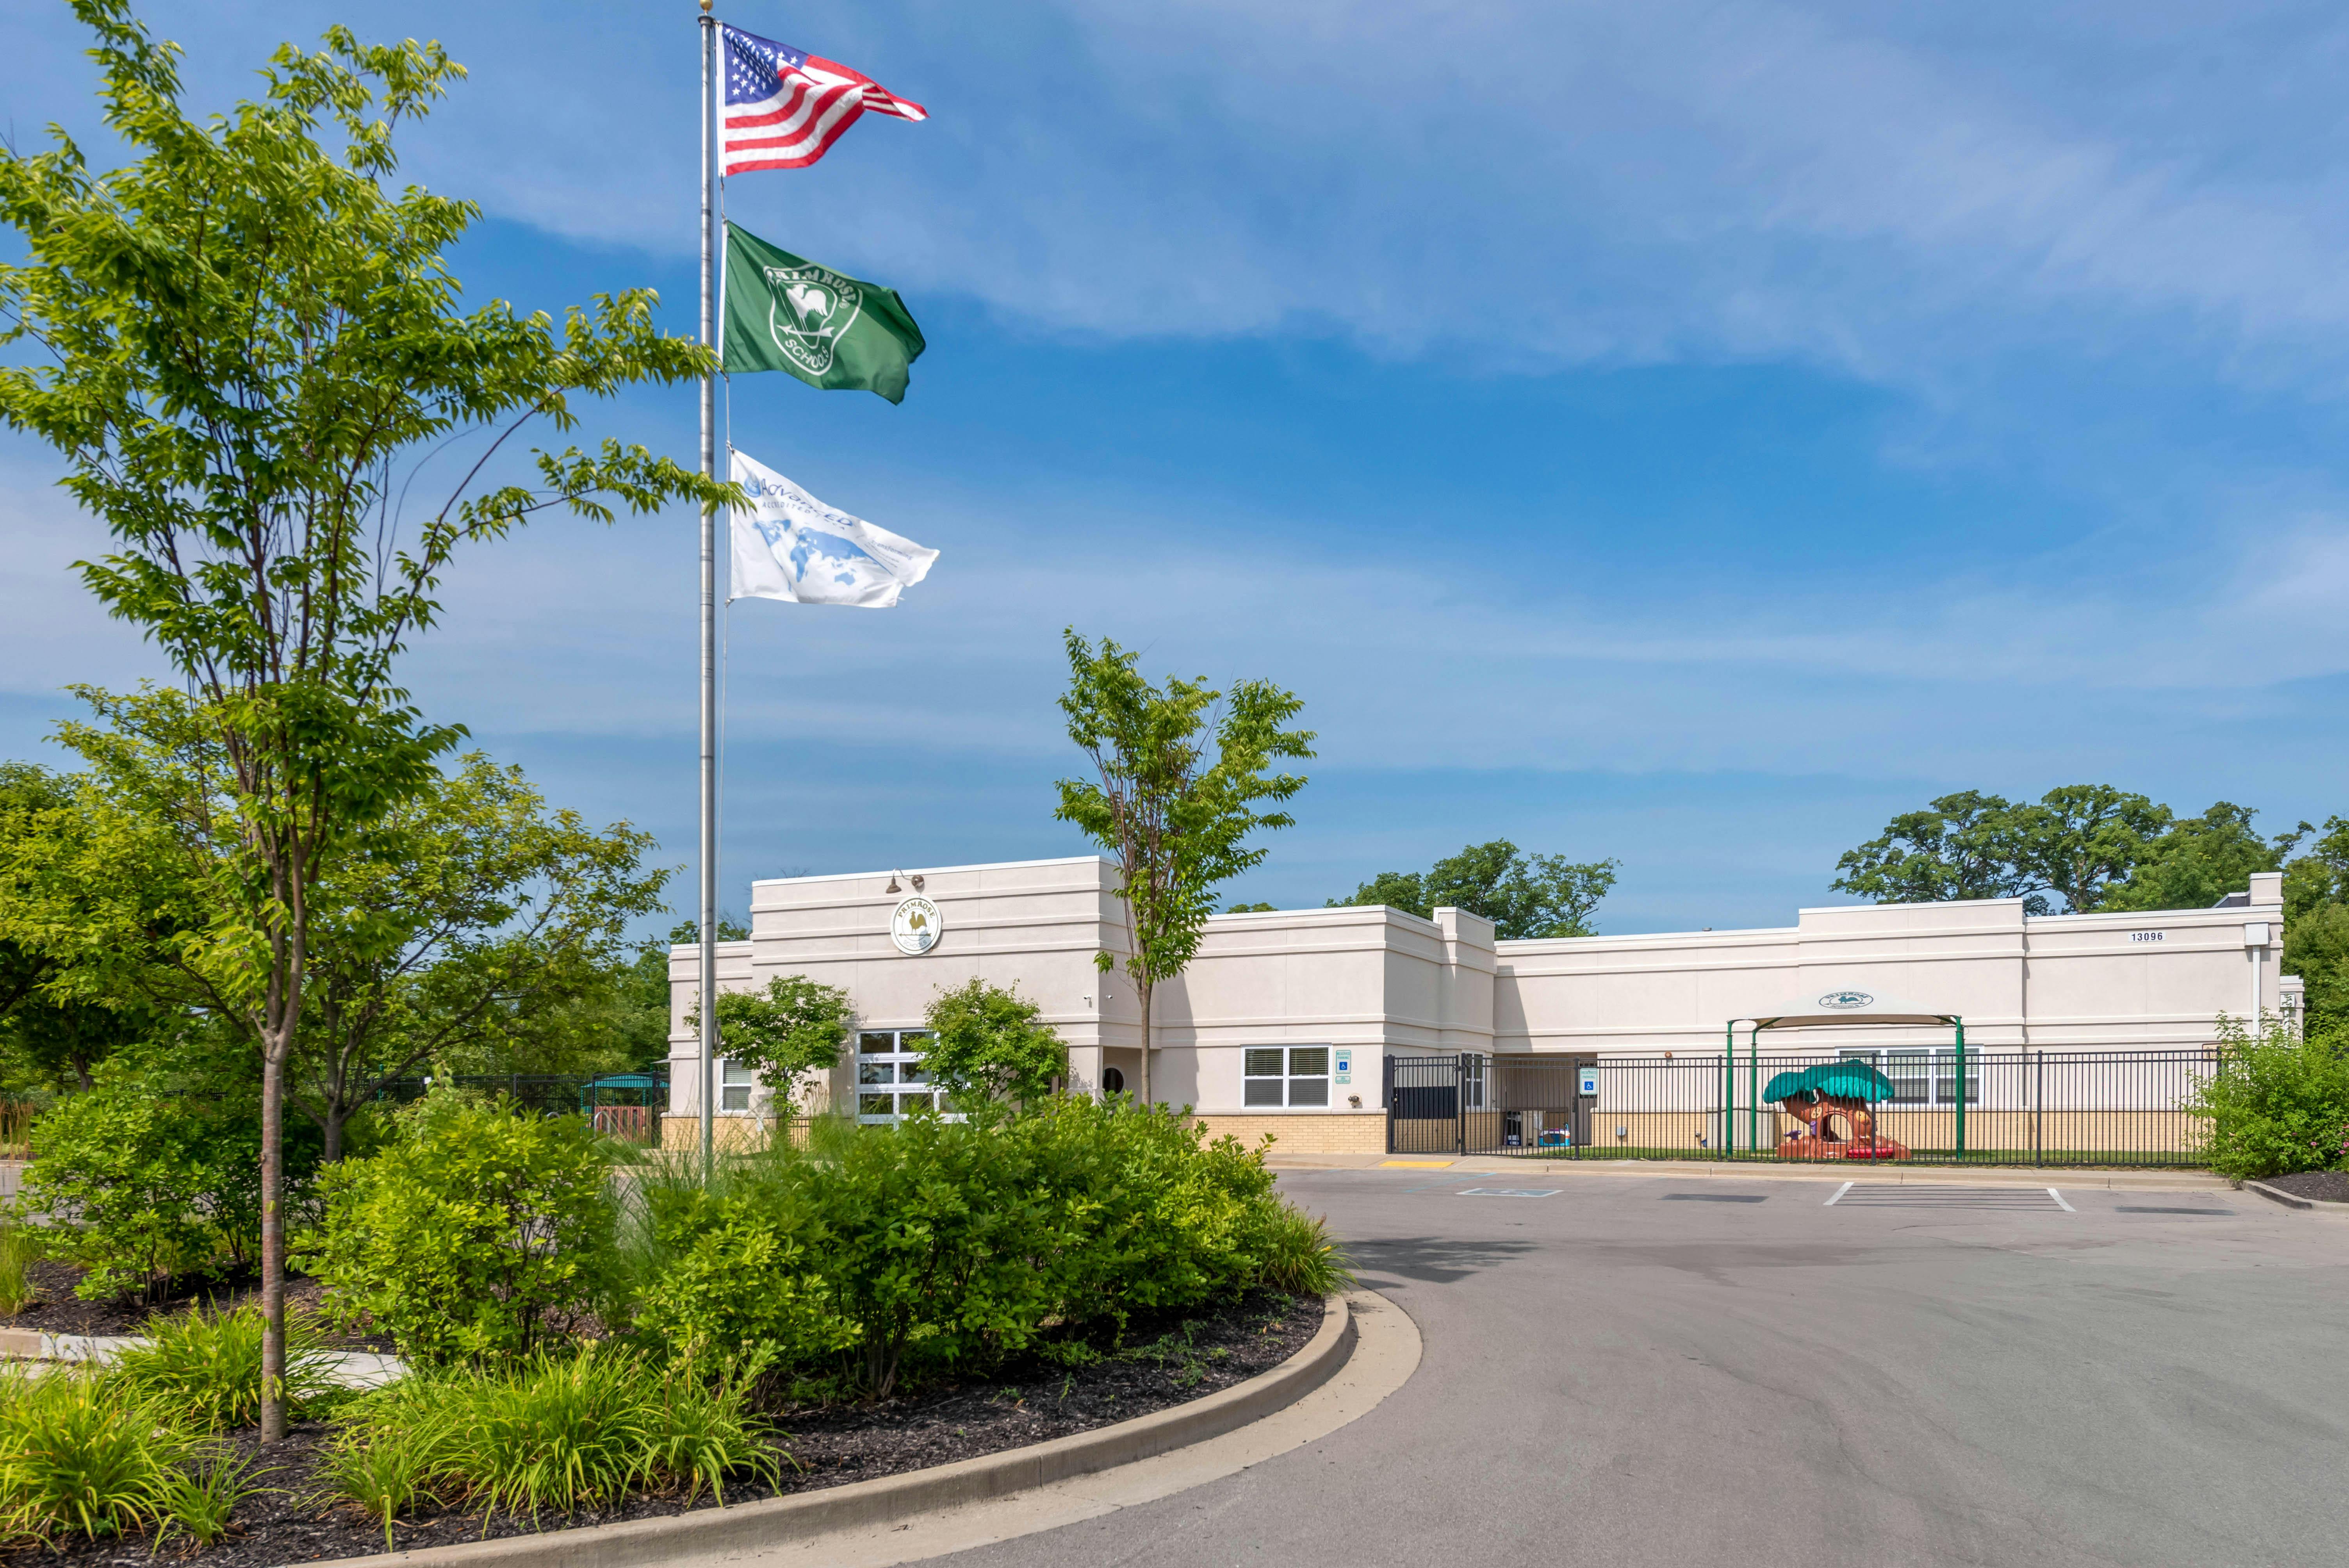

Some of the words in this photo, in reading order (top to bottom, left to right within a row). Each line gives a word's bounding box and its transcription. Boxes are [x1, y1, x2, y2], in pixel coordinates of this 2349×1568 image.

[785, 339, 829, 368] SCHOOLS
[898, 901, 935, 918] PRIMROSE
[2132, 932, 2163, 941] 13096
[904, 940, 927, 948] SCHOOLS
